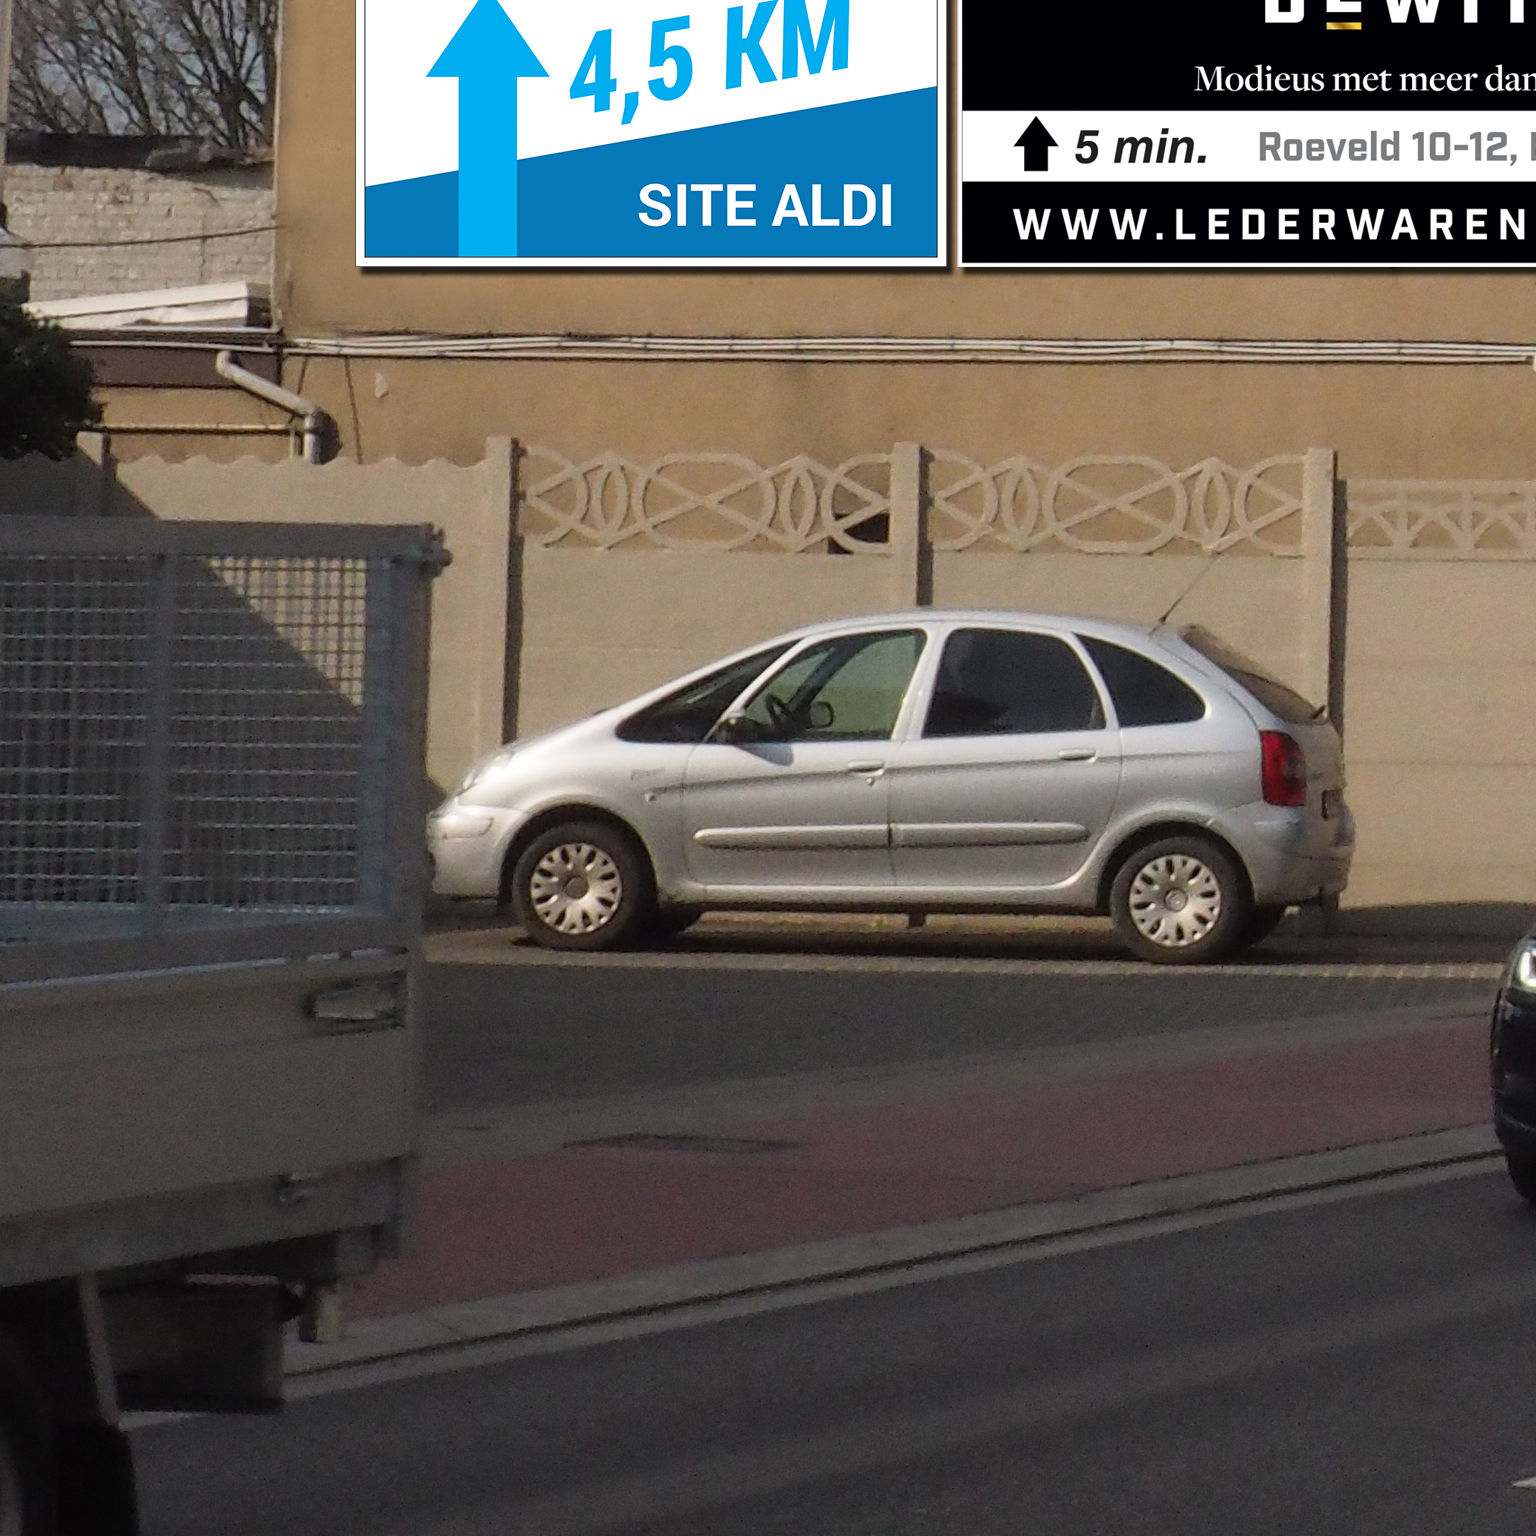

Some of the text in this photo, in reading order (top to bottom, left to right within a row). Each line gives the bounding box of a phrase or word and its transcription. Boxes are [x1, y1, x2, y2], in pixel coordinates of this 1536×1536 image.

[569, 14, 694, 126] 4,5
[1194, 64, 1325, 92] Modieus
[1332, 69, 1392, 92] met
[1399, 72, 1479, 92] meer
[1075, 128, 1208, 164] 5 min.
[1258, 130, 1401, 162] Roeveld
[1412, 131, 1518, 167] 10-12,
[638, 183, 892, 227] SITE ALDI
